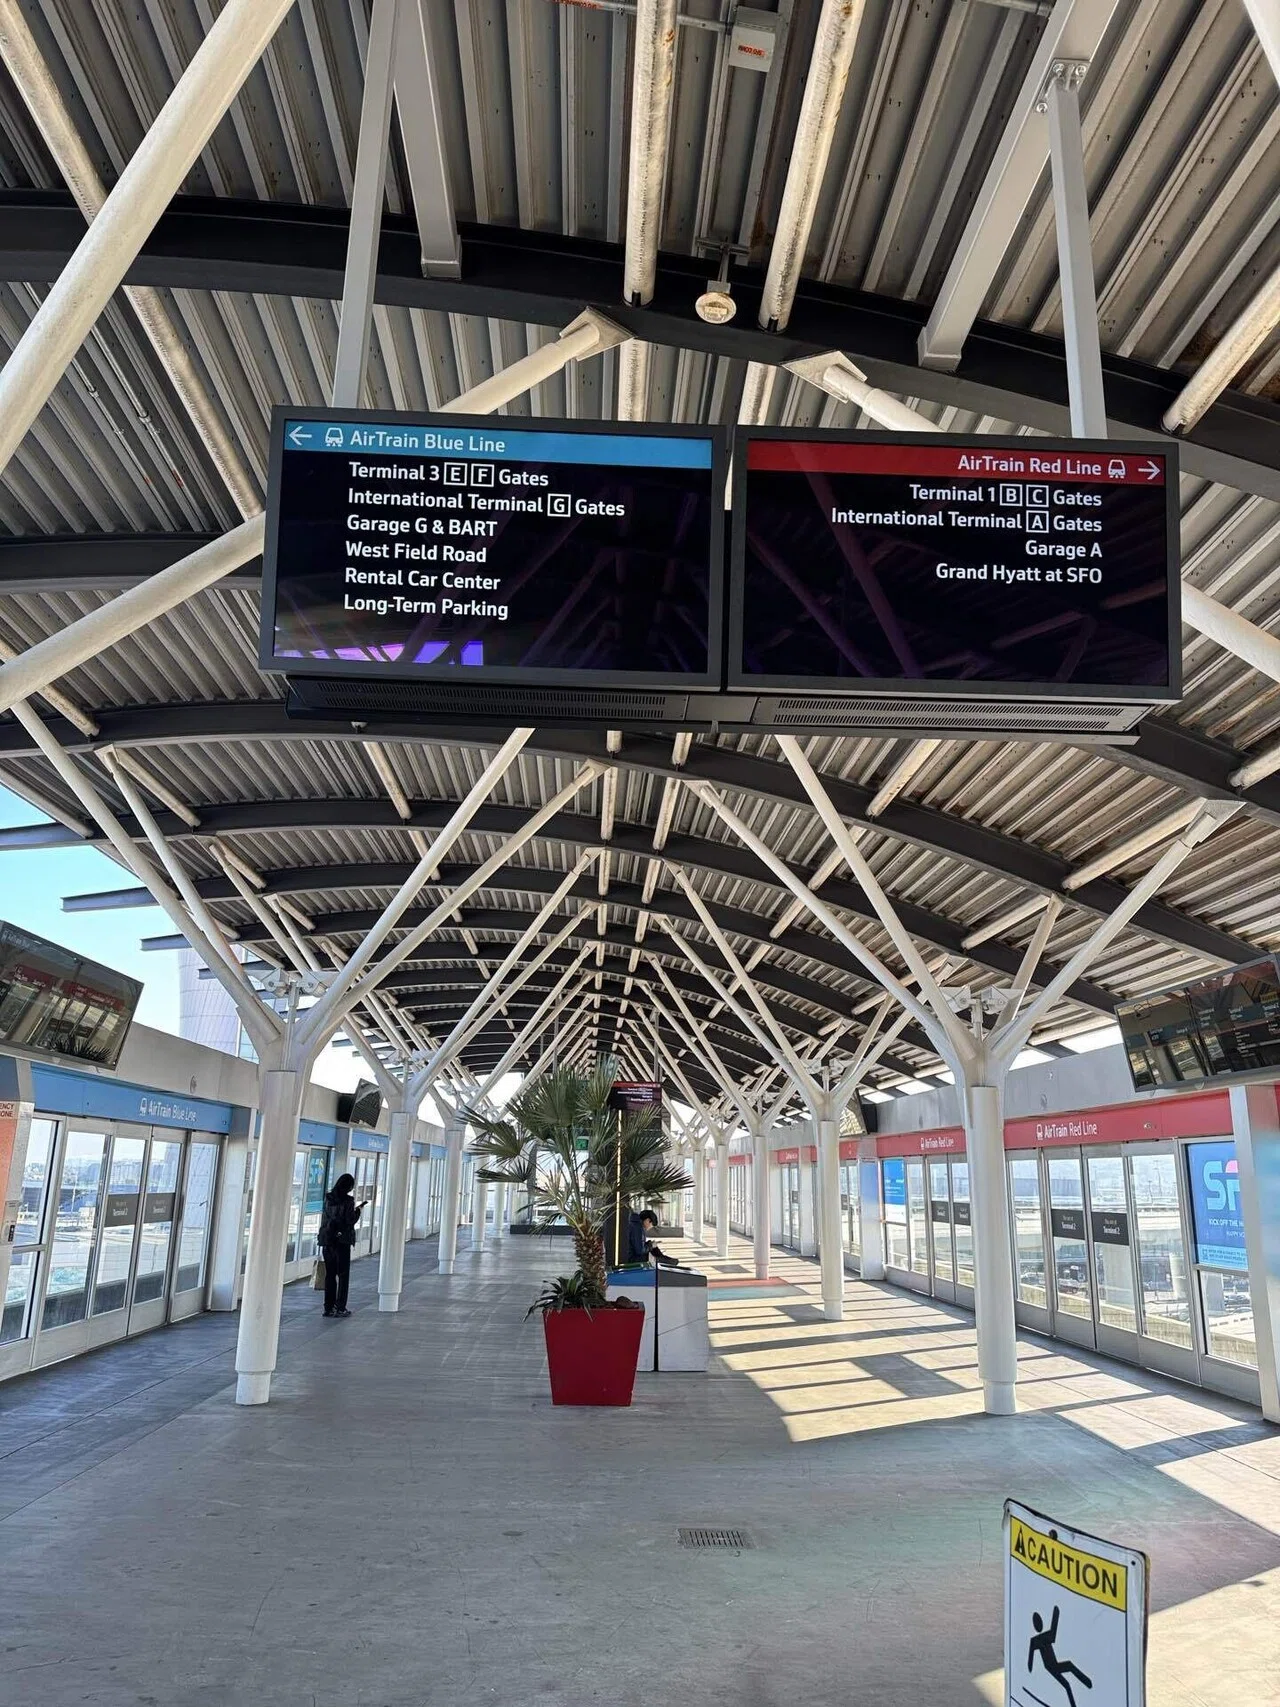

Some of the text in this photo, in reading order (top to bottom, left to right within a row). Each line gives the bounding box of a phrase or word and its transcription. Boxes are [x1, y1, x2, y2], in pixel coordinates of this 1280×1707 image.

[350, 430, 506, 453] AirTrain Blue Line
[348, 461, 426, 481] Terminal
[429, 465, 440, 481] 3
[498, 468, 549, 487] Gates
[957, 454, 1102, 476] AirTrain Red Line
[348, 487, 464, 509] International
[467, 493, 544, 513] Terminal
[575, 498, 625, 517] Gates
[909, 483, 984, 502] Terminal
[987, 486, 995, 502] 1
[1053, 489, 1102, 507] Gates
[346, 514, 498, 537] Garage G & BART
[831, 507, 944, 527] International
[947, 511, 1023, 529] Terminal
[1053, 514, 1103, 532] Gates
[345, 540, 487, 563] West Field Road
[1025, 539, 1103, 561] Garage A
[345, 567, 501, 590] Rental Car Center
[935, 562, 1102, 585] Grand Hyatt at SFO
[344, 593, 509, 621] Long-Term Parking
[148, 1100, 197, 1122] AirTrain Blue Line
[1044, 1120, 1098, 1139] AirTrain Red Line
[1027, 1537, 1118, 1598] CAUTION
